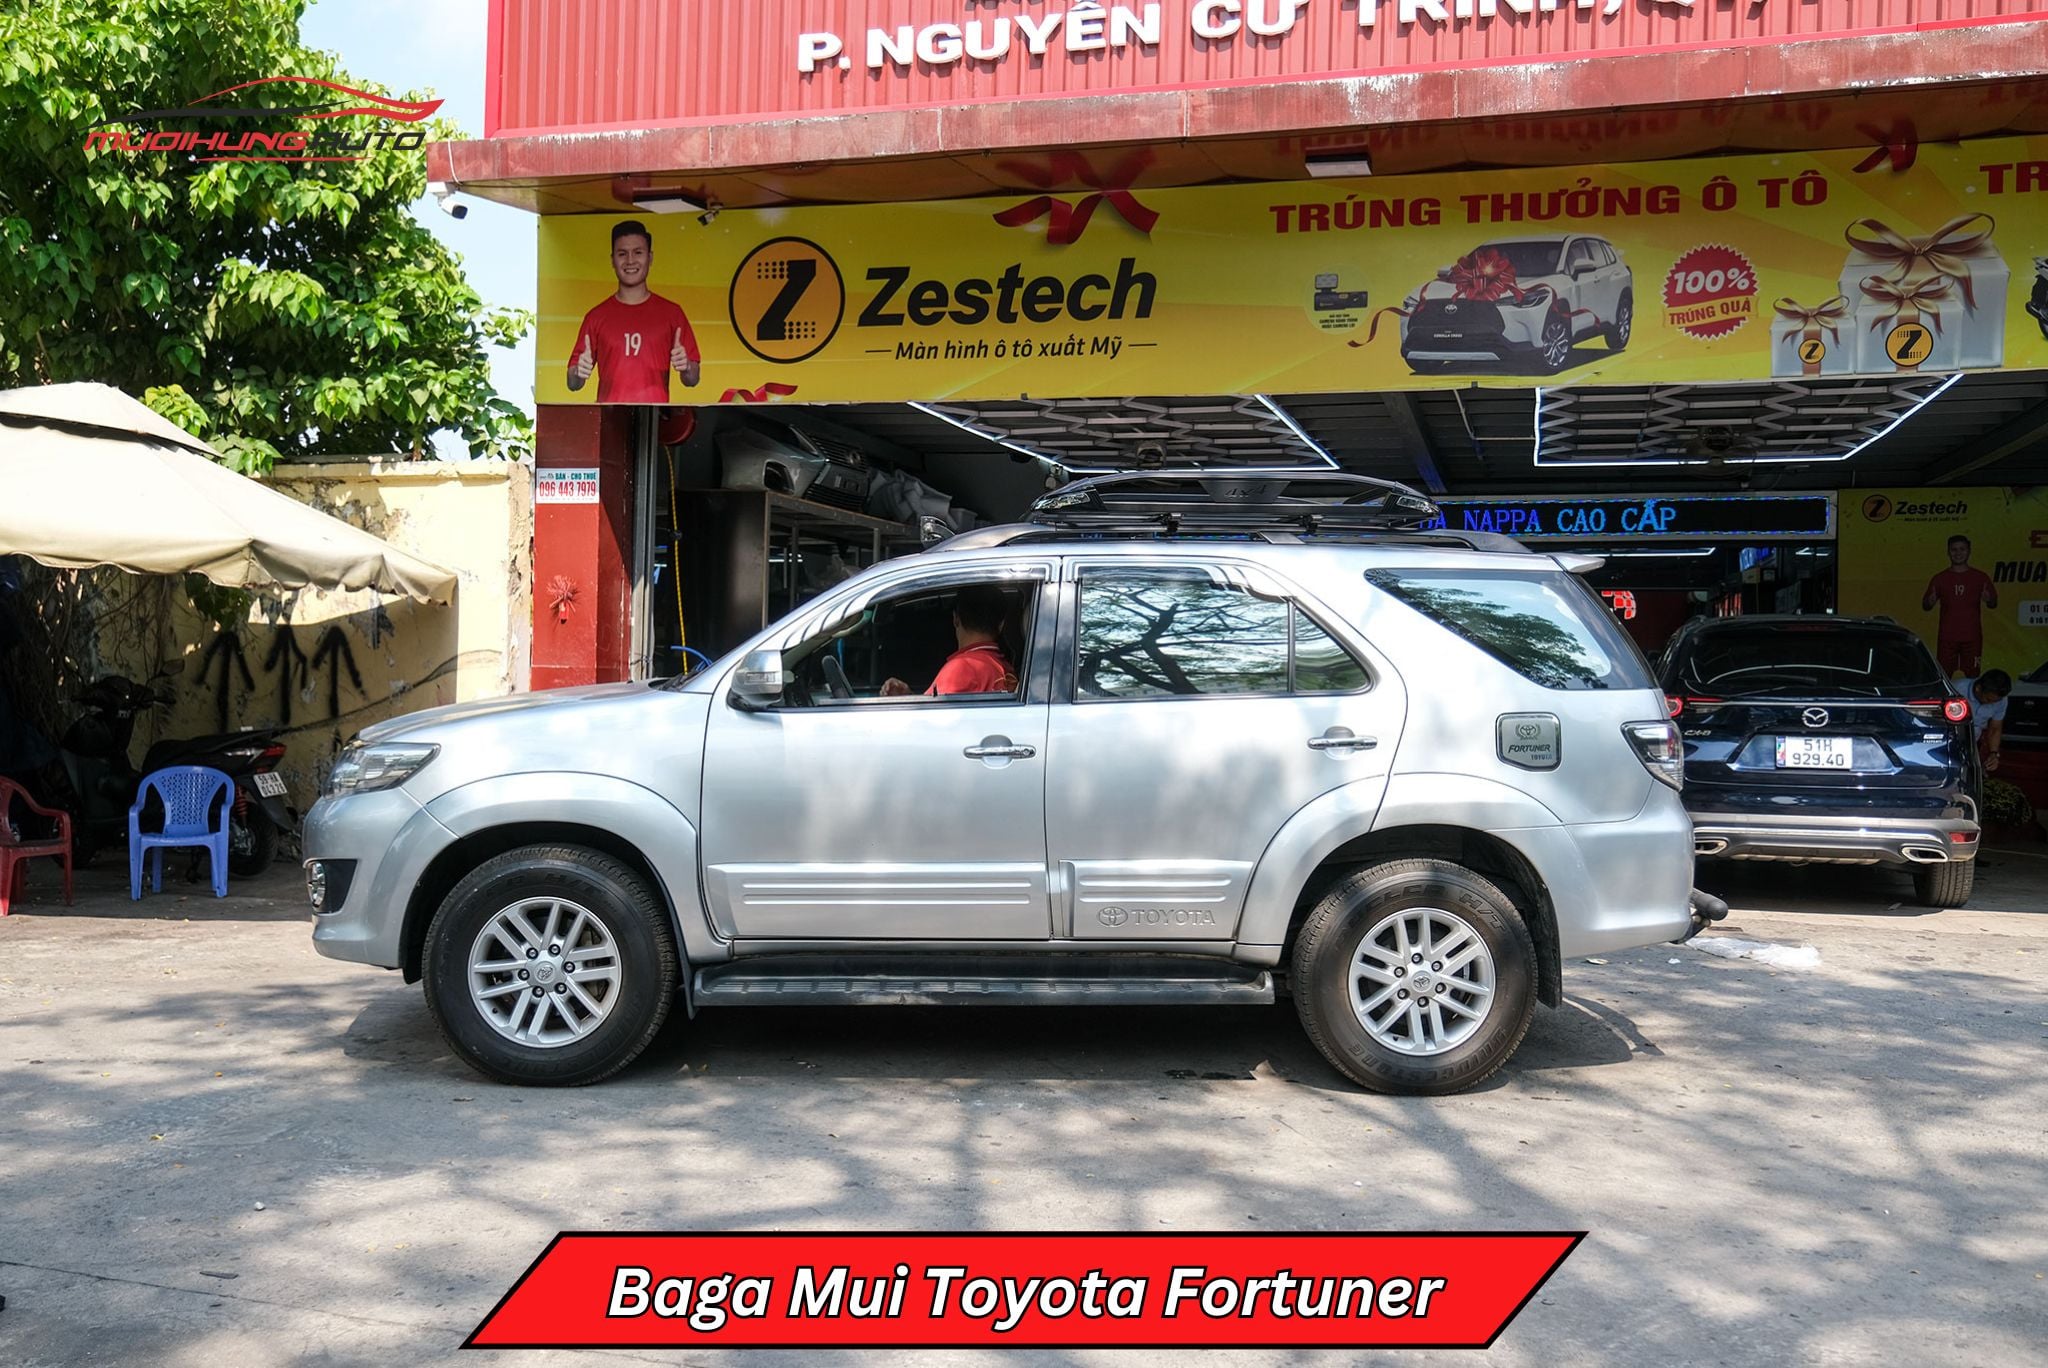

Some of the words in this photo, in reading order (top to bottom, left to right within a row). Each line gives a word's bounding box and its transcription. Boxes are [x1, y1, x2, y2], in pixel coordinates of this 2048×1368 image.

[798, 31, 850, 72] P.
[1269, 194, 1441, 234] TRÚNG
[1460, 177, 1681, 224] THƯỞNG
[1702, 175, 1737, 211] Ô
[1758, 169, 1828, 209] TÔ
[857, 257, 1158, 327] Zestech
[1674, 267, 1751, 294] 100%
[1669, 305, 1717, 325] TRÚNG
[1720, 296, 1752, 316] QUẢ
[624, 332, 642, 357] 19
[895, 342, 938, 360] Màn
[944, 340, 988, 359] hình
[994, 338, 1007, 358] ô
[1012, 338, 1033, 357] tô
[1038, 333, 1086, 357] xuất
[1090, 335, 1122, 360] Mỹ
[540, 481, 556, 497] 096
[559, 481, 574, 497] 443
[577, 481, 597, 497] 7979
[1463, 508, 1542, 533] NAPPA
[1557, 508, 1606, 532] CAO
[1621, 499, 1676, 531] CẤP
[1895, 501, 1967, 515] Zestech
[1993, 561, 2048, 583] MUA
[1955, 584, 1965, 596] 19
[1508, 744, 1550, 753] FORTUNER
[1804, 739, 1832, 751] 51H
[1792, 753, 1844, 766] 929.40
[1131, 909, 1216, 925] TOYOTA
